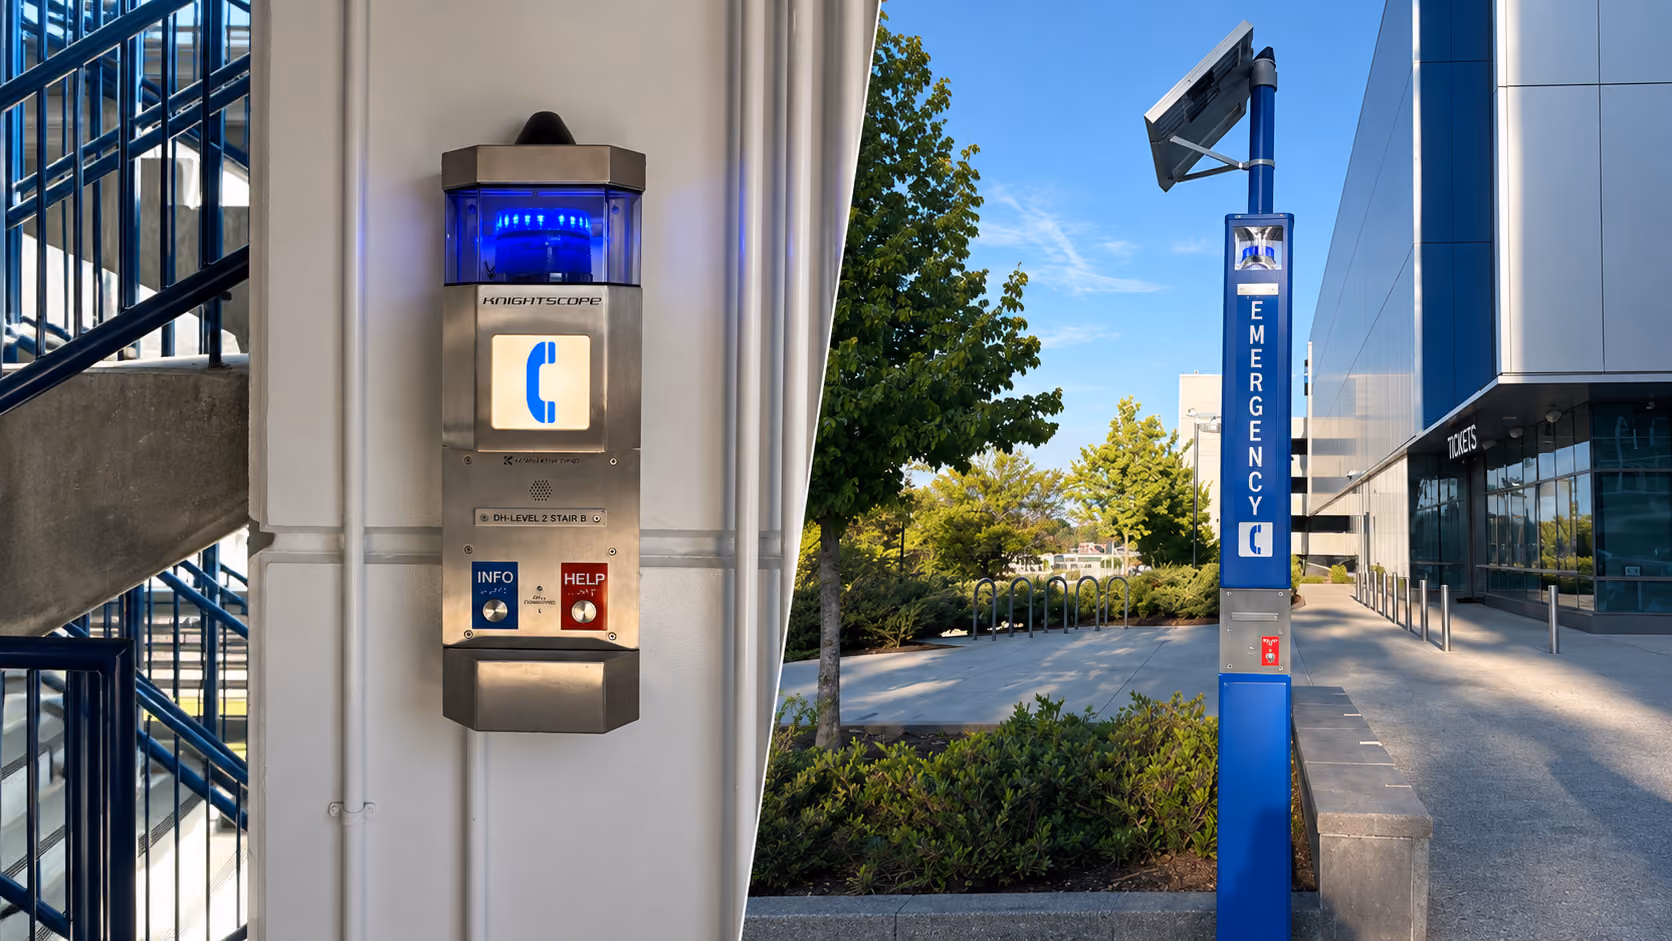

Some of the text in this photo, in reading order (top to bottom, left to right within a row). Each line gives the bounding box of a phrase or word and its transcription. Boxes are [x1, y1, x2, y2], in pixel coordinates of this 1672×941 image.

[482, 296, 602, 306] KNIGHTSCOPE
[1248, 300, 1264, 516] EMERGENCY
[1447, 424, 1477, 459] TICKETS
[493, 514, 587, 522] DH-LEVEL 2 STAIR B
[477, 571, 513, 583] INFO
[564, 573, 605, 586] HELP
